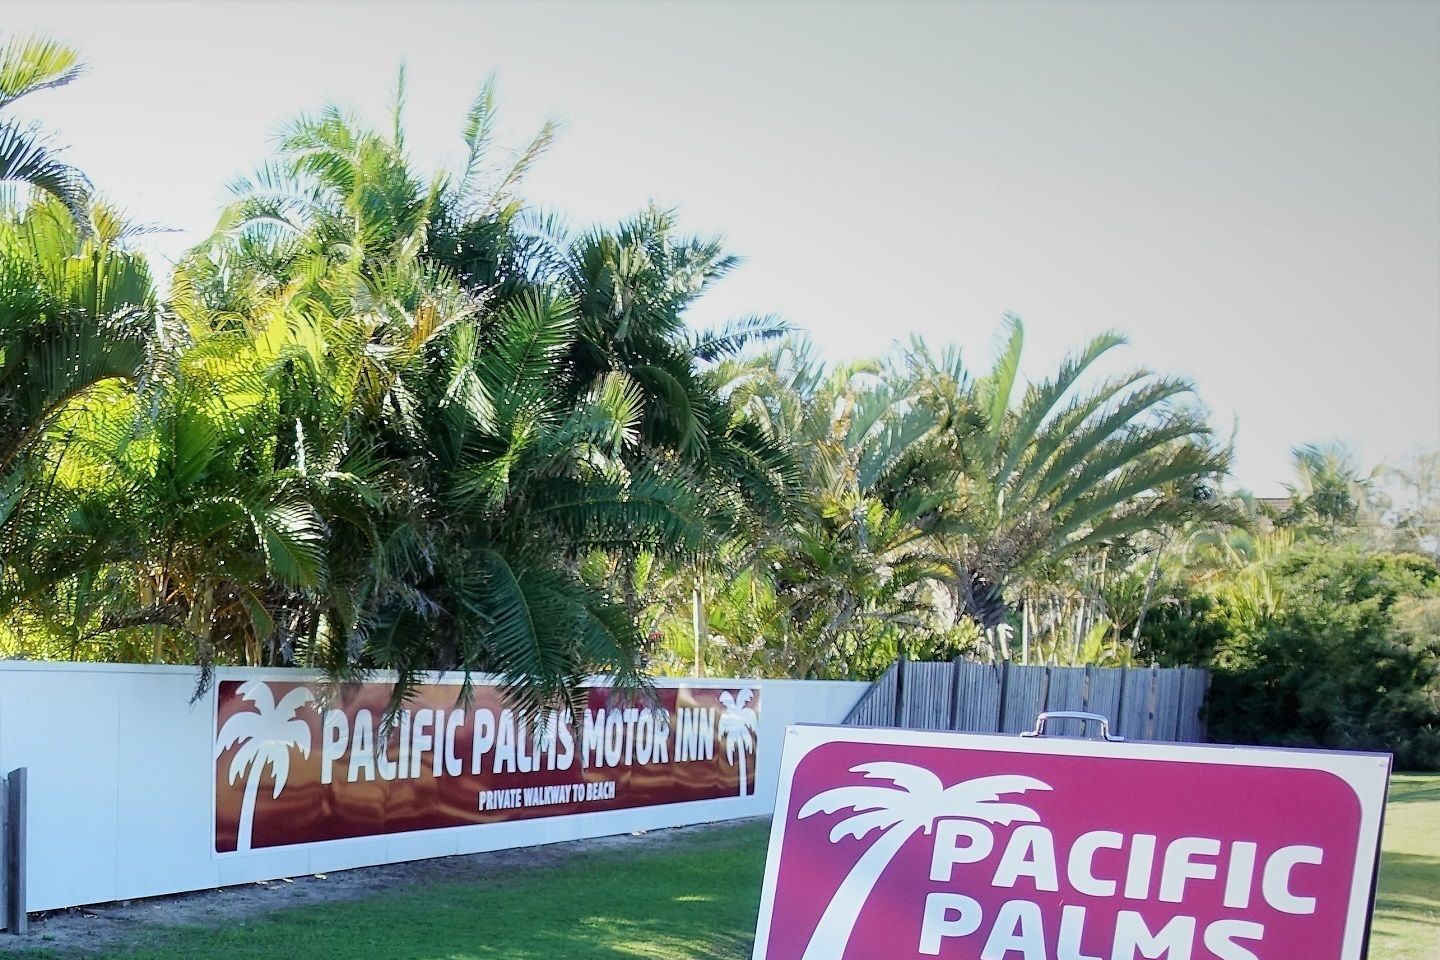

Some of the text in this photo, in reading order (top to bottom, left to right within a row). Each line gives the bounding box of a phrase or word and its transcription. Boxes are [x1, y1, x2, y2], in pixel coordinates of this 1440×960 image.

[321, 707, 716, 784] PACIFIC PALMS MOTOR INN
[478, 781, 616, 811] PRIVATE WALKWAY TO BEACH
[927, 818, 1324, 916] PACIFIC
